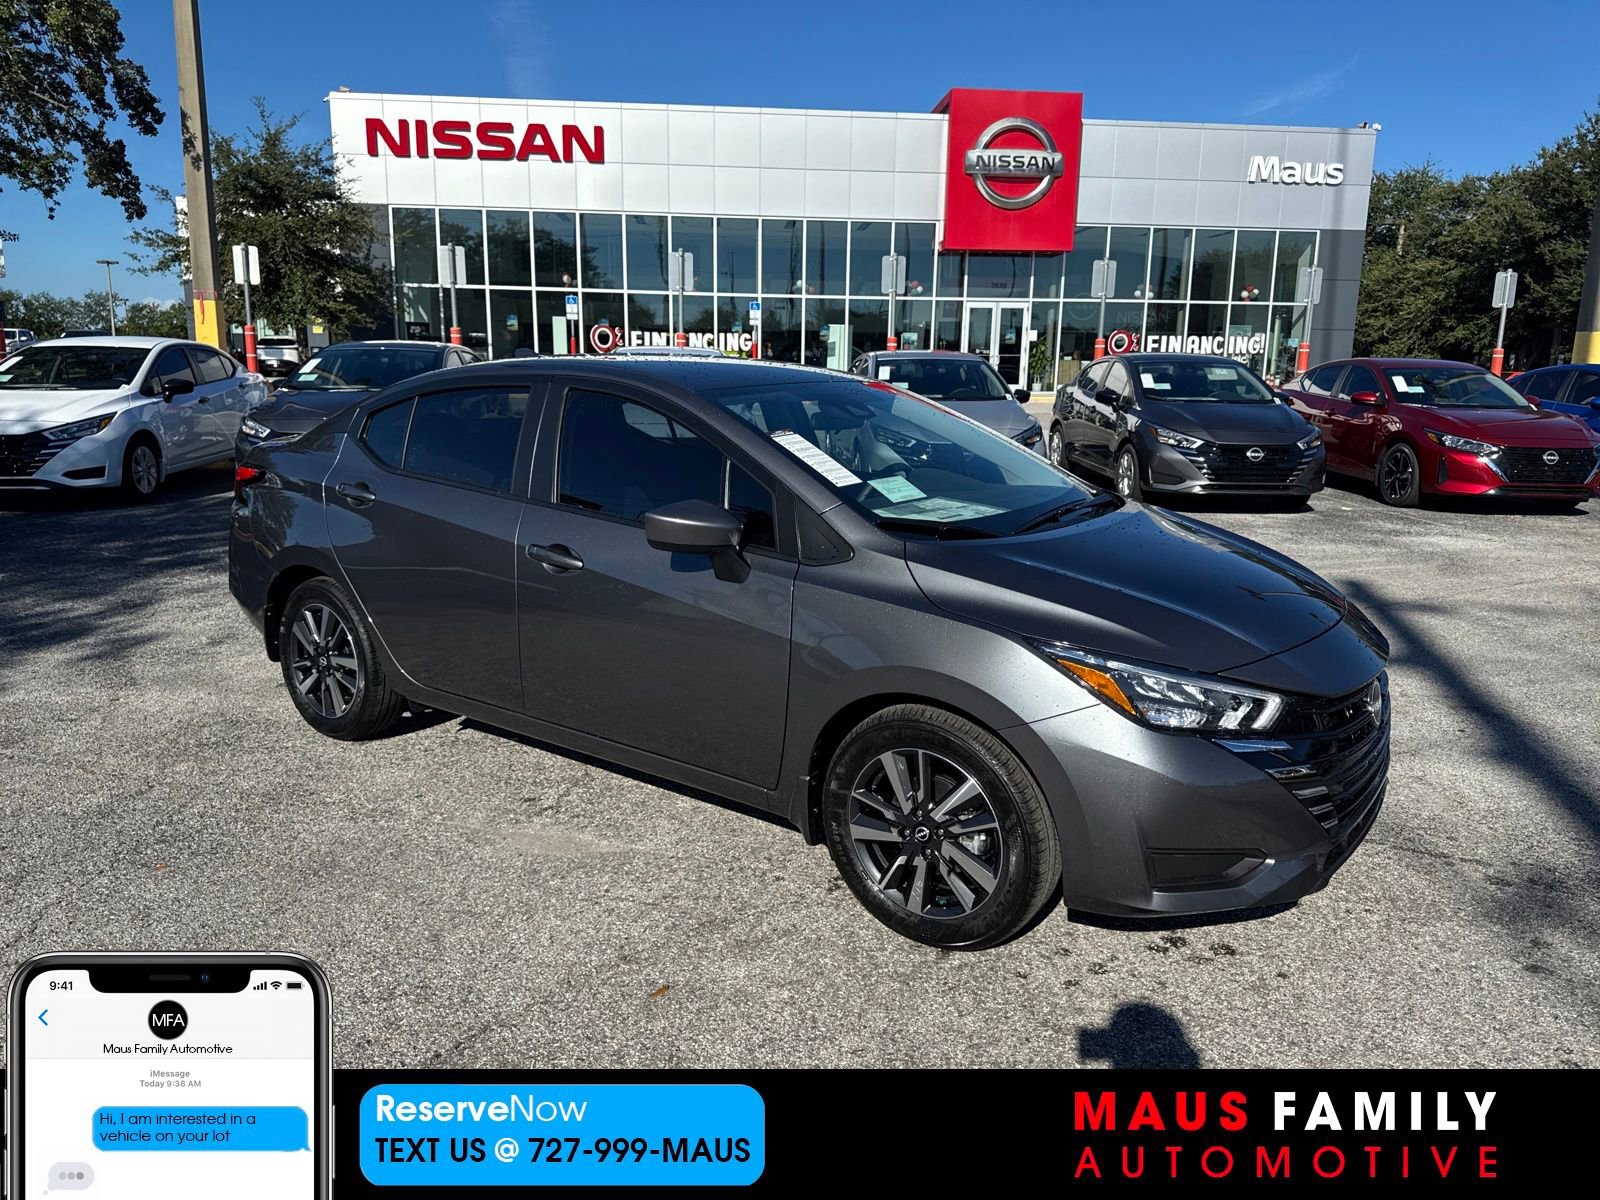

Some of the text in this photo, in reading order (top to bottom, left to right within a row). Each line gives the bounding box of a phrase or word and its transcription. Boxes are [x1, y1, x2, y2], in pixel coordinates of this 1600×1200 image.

[365, 117, 605, 165] NISSAN
[975, 154, 1055, 171] NISSAN
[1247, 155, 1344, 187] Maus
[1146, 333, 1266, 354] FINANCING!
